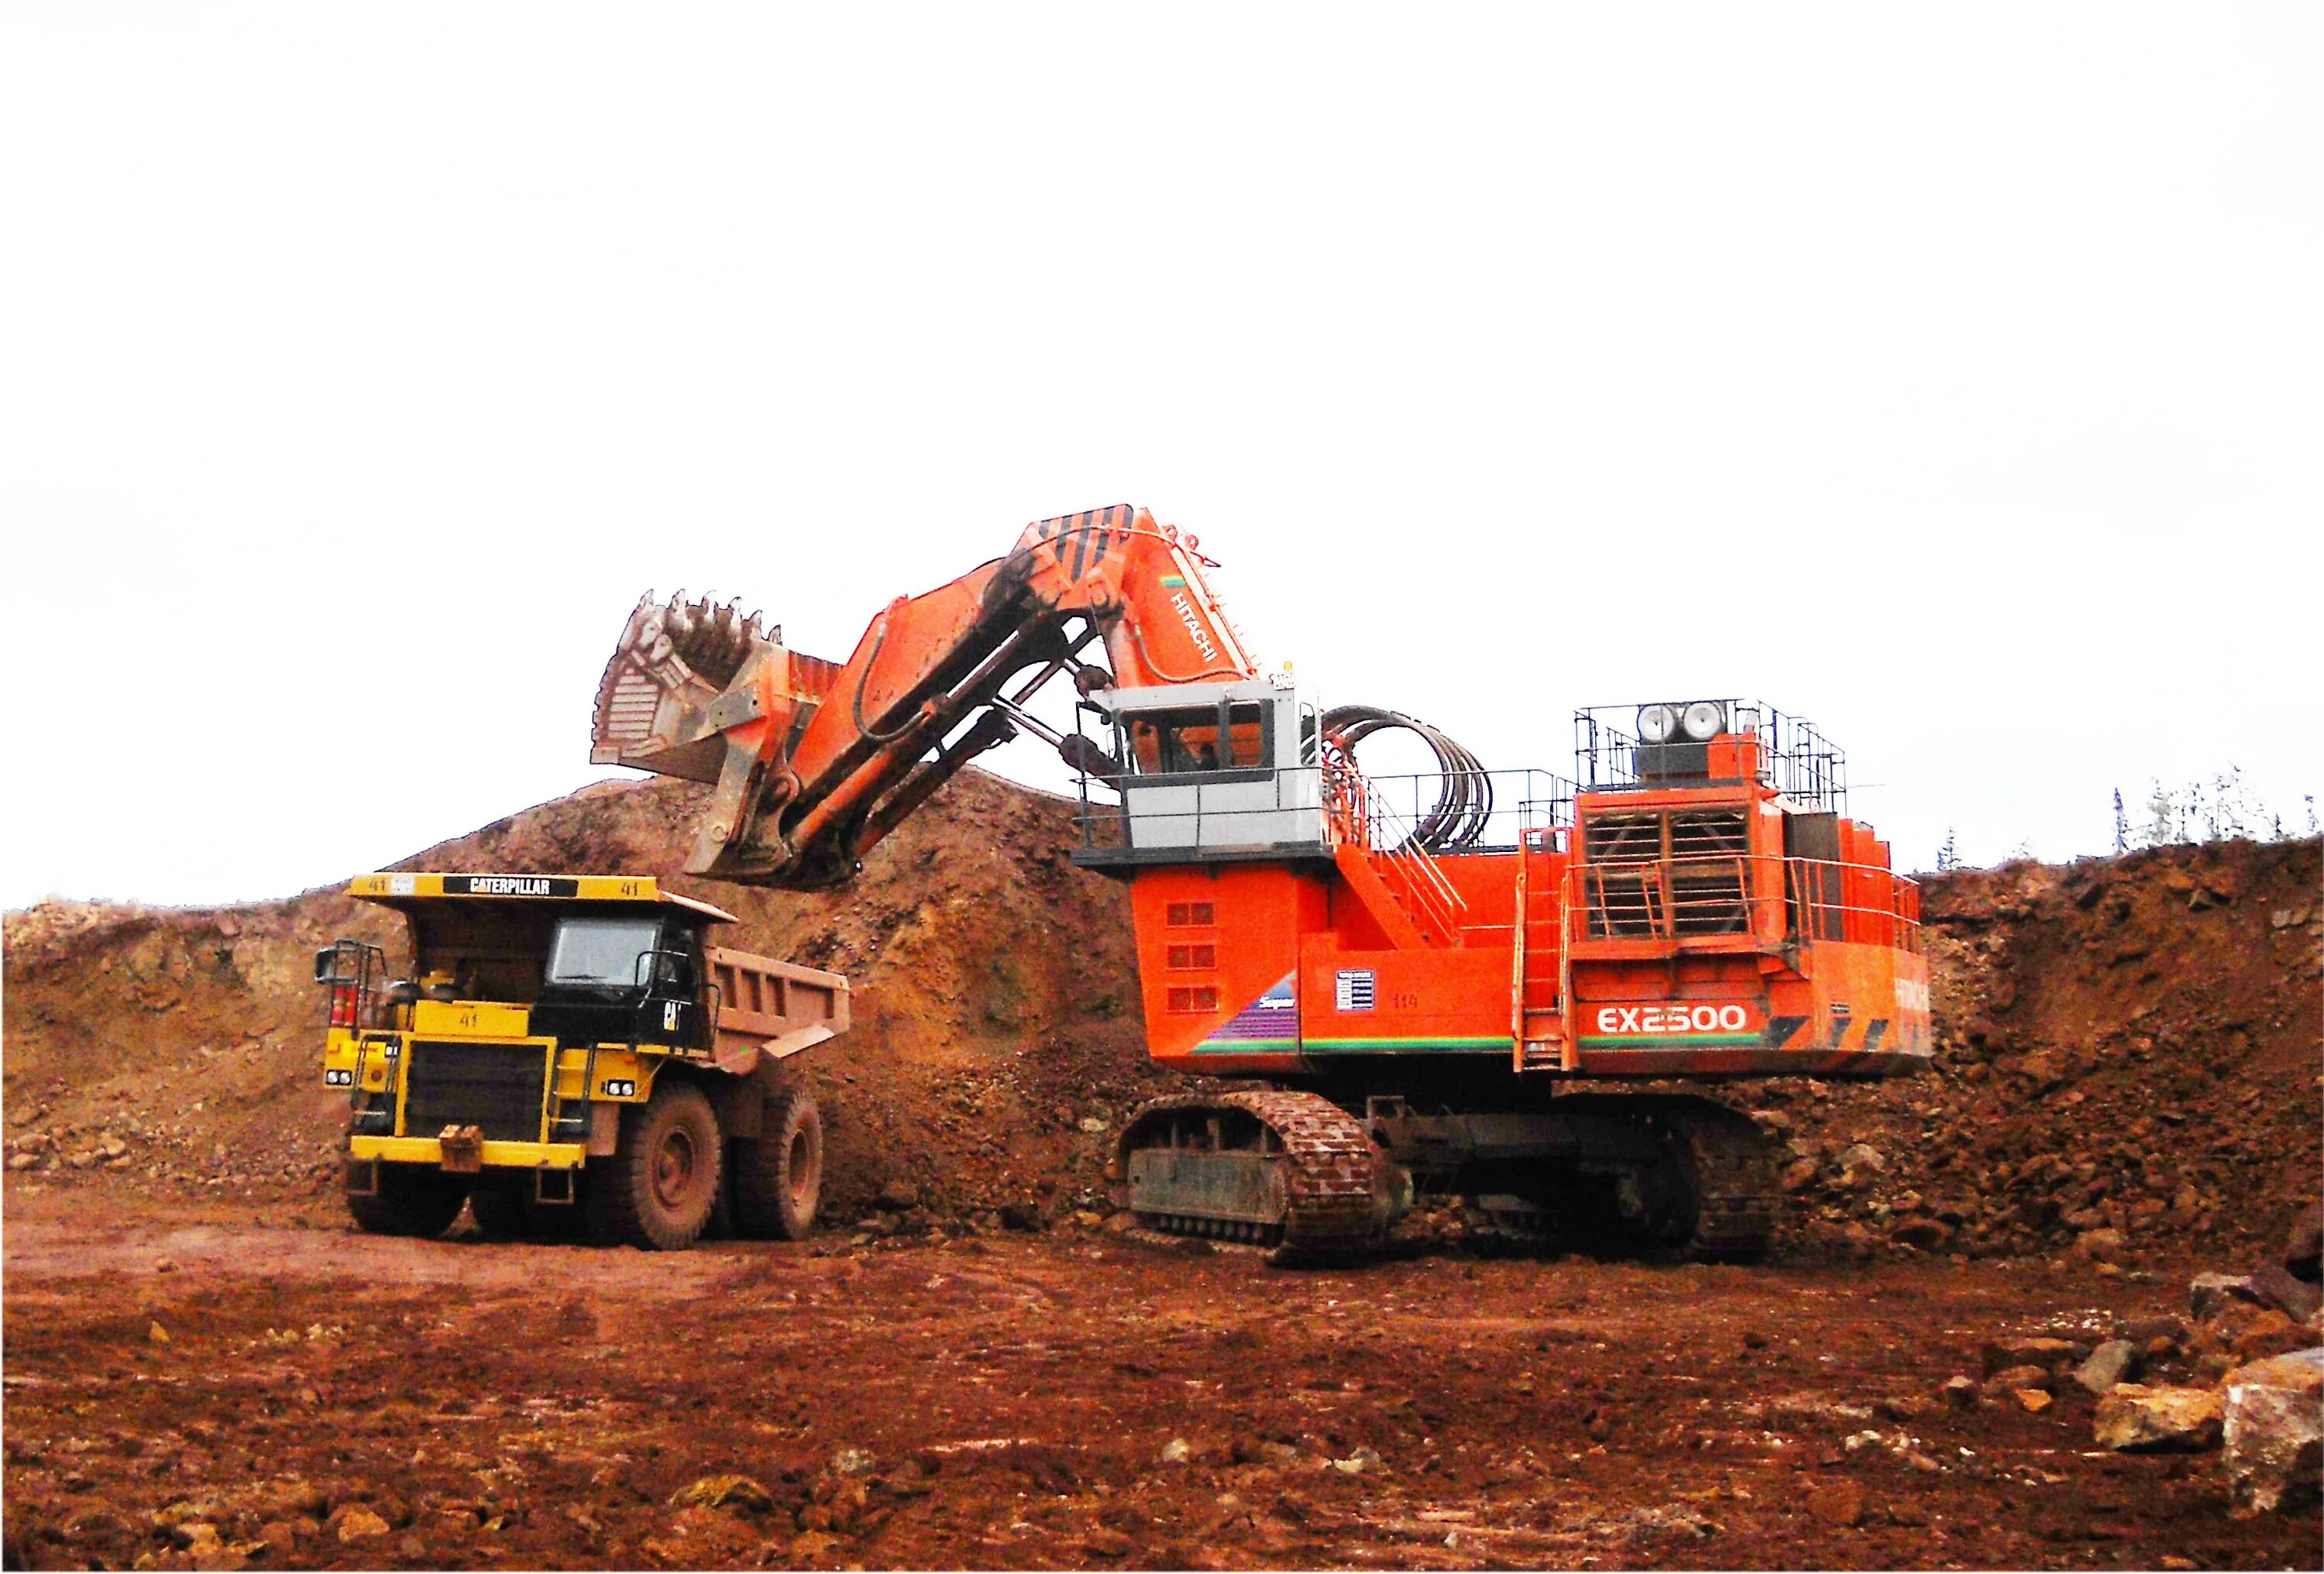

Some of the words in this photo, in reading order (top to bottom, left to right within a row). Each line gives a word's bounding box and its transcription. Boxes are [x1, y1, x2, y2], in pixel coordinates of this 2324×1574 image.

[1171, 592, 1218, 662] HITACHI
[368, 878, 386, 891] 41
[469, 878, 550, 895] CATERPILLAR
[621, 882, 638, 896] 41
[1393, 993, 1418, 1009] 114
[459, 1012, 477, 1027] 41
[1597, 1005, 1746, 1033] EX2500
